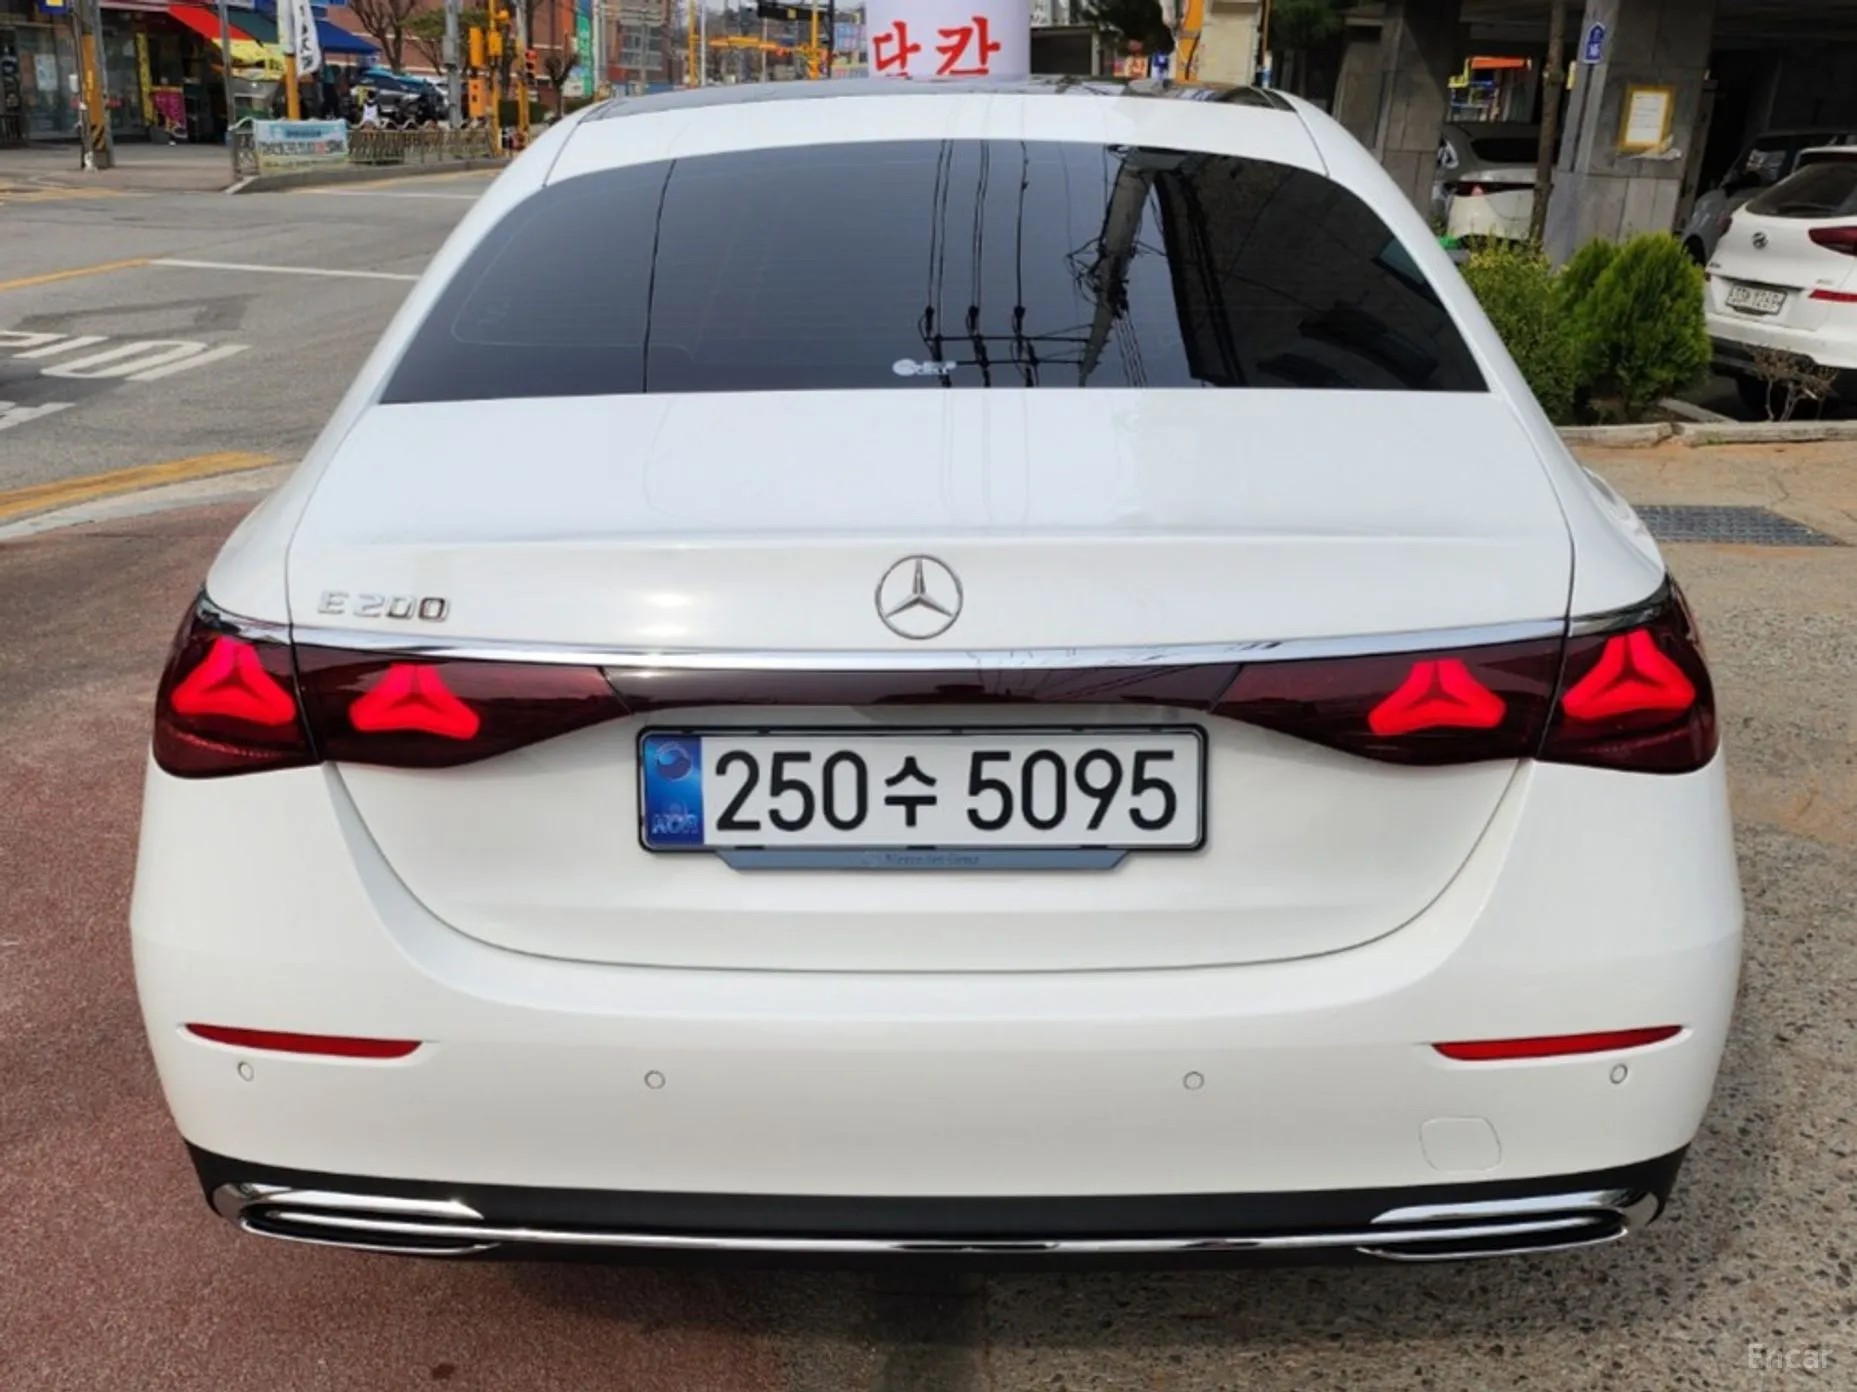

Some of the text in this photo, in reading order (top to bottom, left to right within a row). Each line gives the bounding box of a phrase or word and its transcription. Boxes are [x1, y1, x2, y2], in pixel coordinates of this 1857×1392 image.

[318, 590, 450, 622] E 200
[715, 748, 1178, 832] 250수 5095
